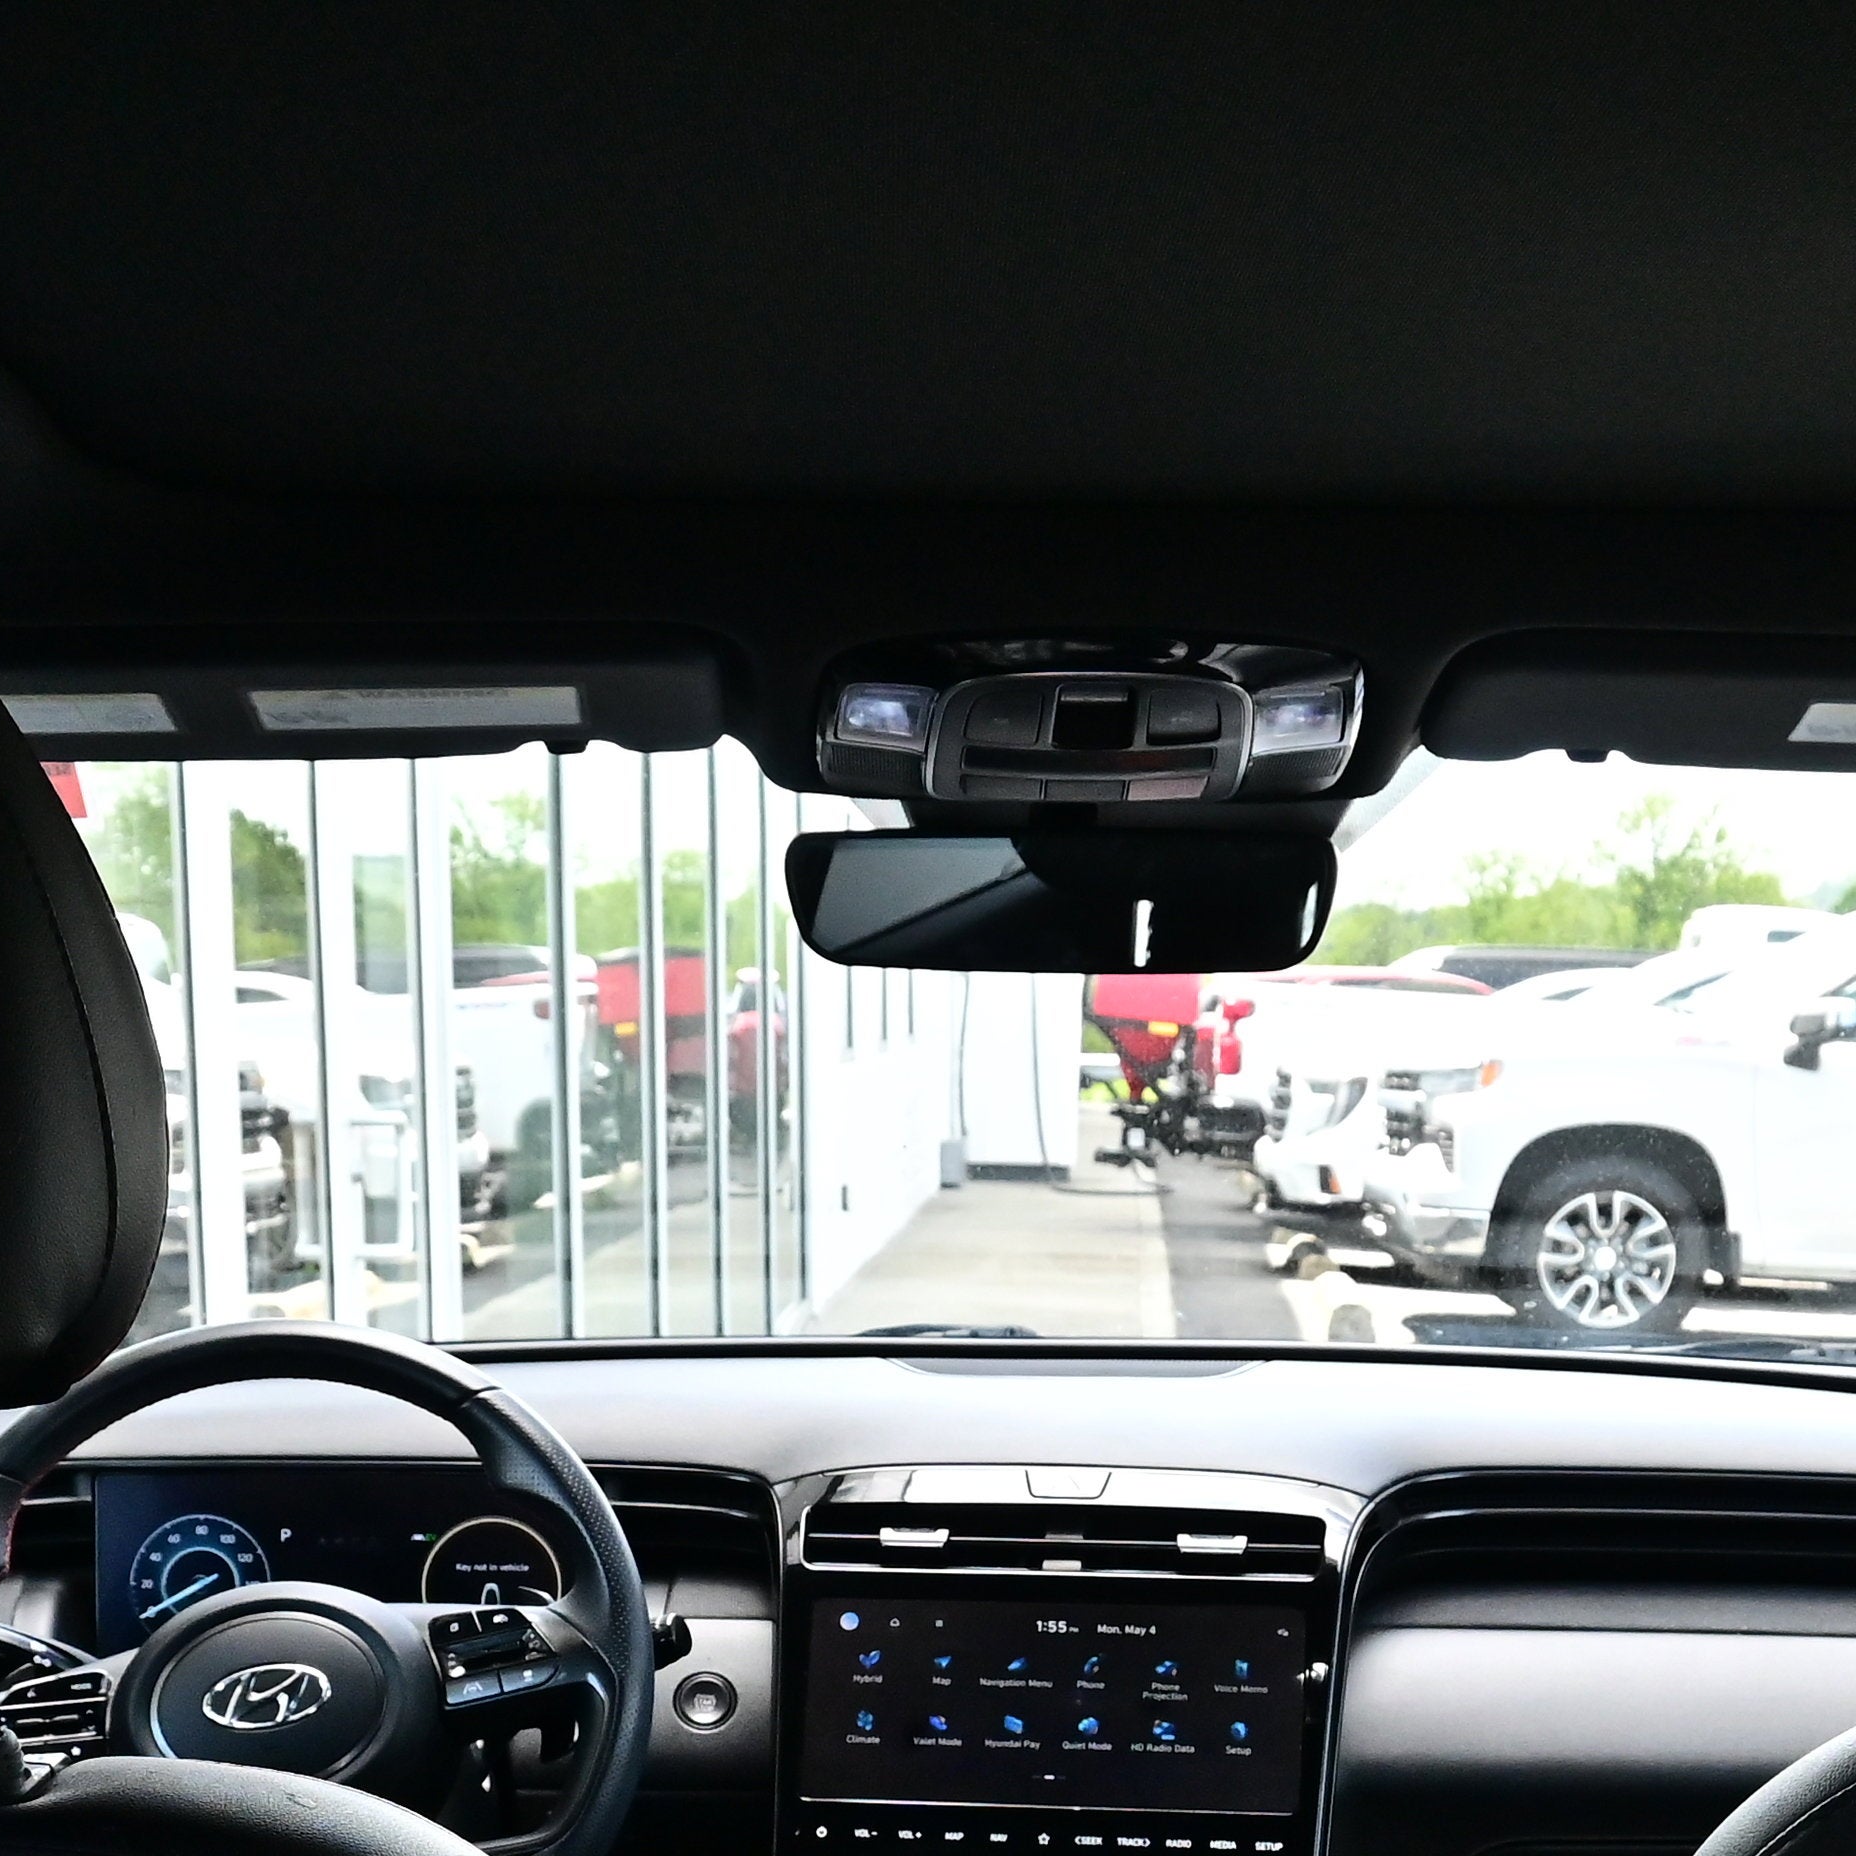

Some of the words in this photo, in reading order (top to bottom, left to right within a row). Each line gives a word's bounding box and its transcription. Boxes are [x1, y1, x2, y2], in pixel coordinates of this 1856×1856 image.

[280, 1527, 292, 1543] P
[456, 1564, 471, 1572] Key
[500, 1563, 529, 1571] vehicle
[1036, 1620, 1068, 1634] 1:55
[1097, 1624, 1122, 1634] Mon.
[1125, 1625, 1146, 1636] May
[1148, 1625, 1157, 1635] 4
[852, 1673, 883, 1685] Hybrid
[932, 1676, 952, 1687] Map
[980, 1678, 1026, 1688] Navigation
[1028, 1679, 1053, 1688] Menu
[1076, 1679, 1106, 1690] Phone
[1152, 1682, 1180, 1691] Phone
[1214, 1684, 1238, 1693] Voice
[1241, 1685, 1268, 1693] Memo
[1143, 1692, 1188, 1701] Projection
[845, 1733, 881, 1745] Climate
[914, 1737, 936, 1745] Valet
[938, 1738, 962, 1746] Mode
[985, 1739, 1021, 1749] Hyundai
[1024, 1740, 1041, 1750] Pay
[1062, 1741, 1086, 1750] Quiet
[1088, 1742, 1112, 1750] Mode
[1131, 1743, 1144, 1751] HD
[1146, 1744, 1172, 1752] Radio
[1175, 1744, 1195, 1753] Data
[1225, 1744, 1252, 1757] Setup
[944, 1831, 965, 1841] MAP
[989, 1833, 1008, 1842] NAV
[1165, 1838, 1192, 1849] RADIO
[1209, 1839, 1237, 1850] MEDIA
[1254, 1841, 1284, 1852] SETUP
